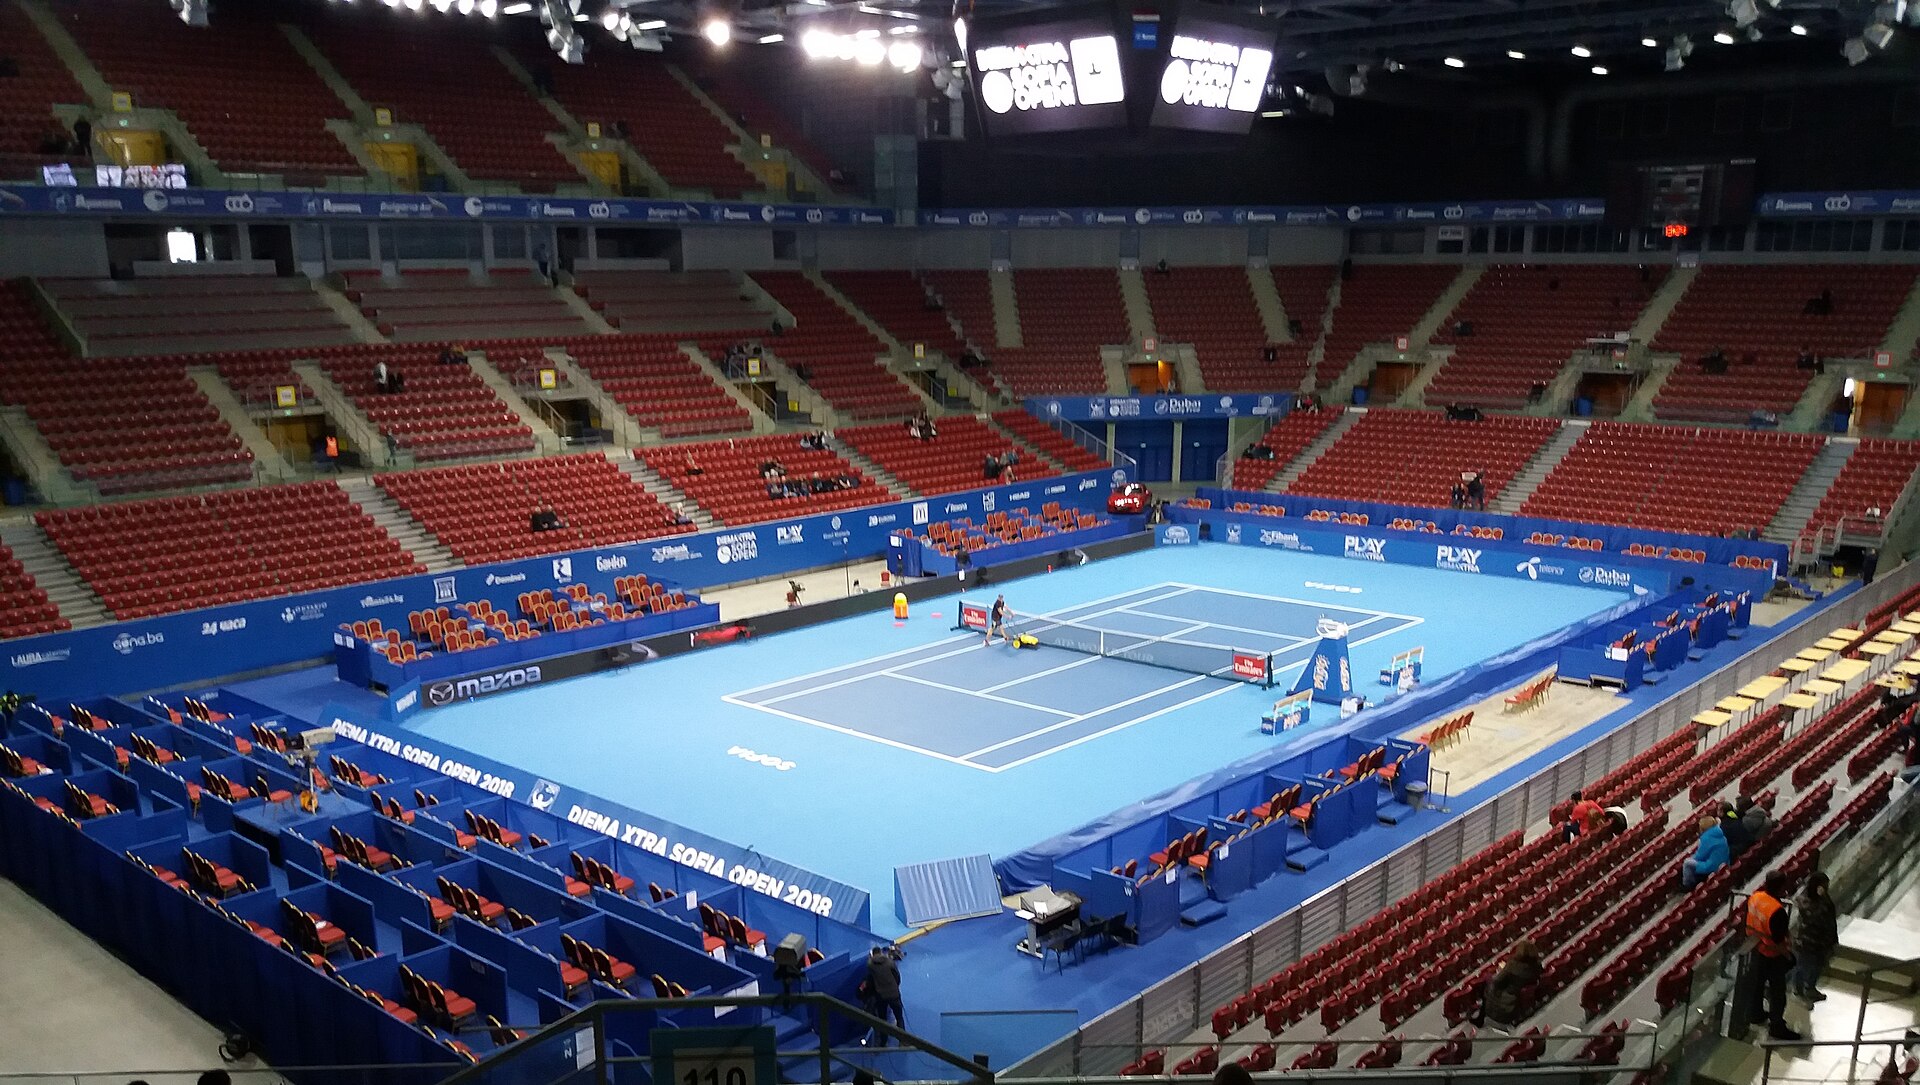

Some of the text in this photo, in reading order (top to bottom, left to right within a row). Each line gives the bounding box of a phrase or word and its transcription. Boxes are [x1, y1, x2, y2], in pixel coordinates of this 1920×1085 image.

[777, 524, 803, 542] PLAY
[1344, 535, 1386, 554] PLAY
[1437, 545, 1482, 565] PLAY
[1595, 567, 1631, 582] Dubai
[201, 621, 218, 636] 24
[11, 651, 42, 667] LAURA
[1234, 663, 1263, 676] Emirates
[457, 666, 541, 698] mazda
[368, 731, 400, 756] XTRA
[401, 744, 440, 771] SOFIA
[441, 760, 481, 786] OPEN
[479, 773, 515, 798] 2018
[567, 804, 833, 917] DIEMA XTRA SOFIA OPEN 2018
